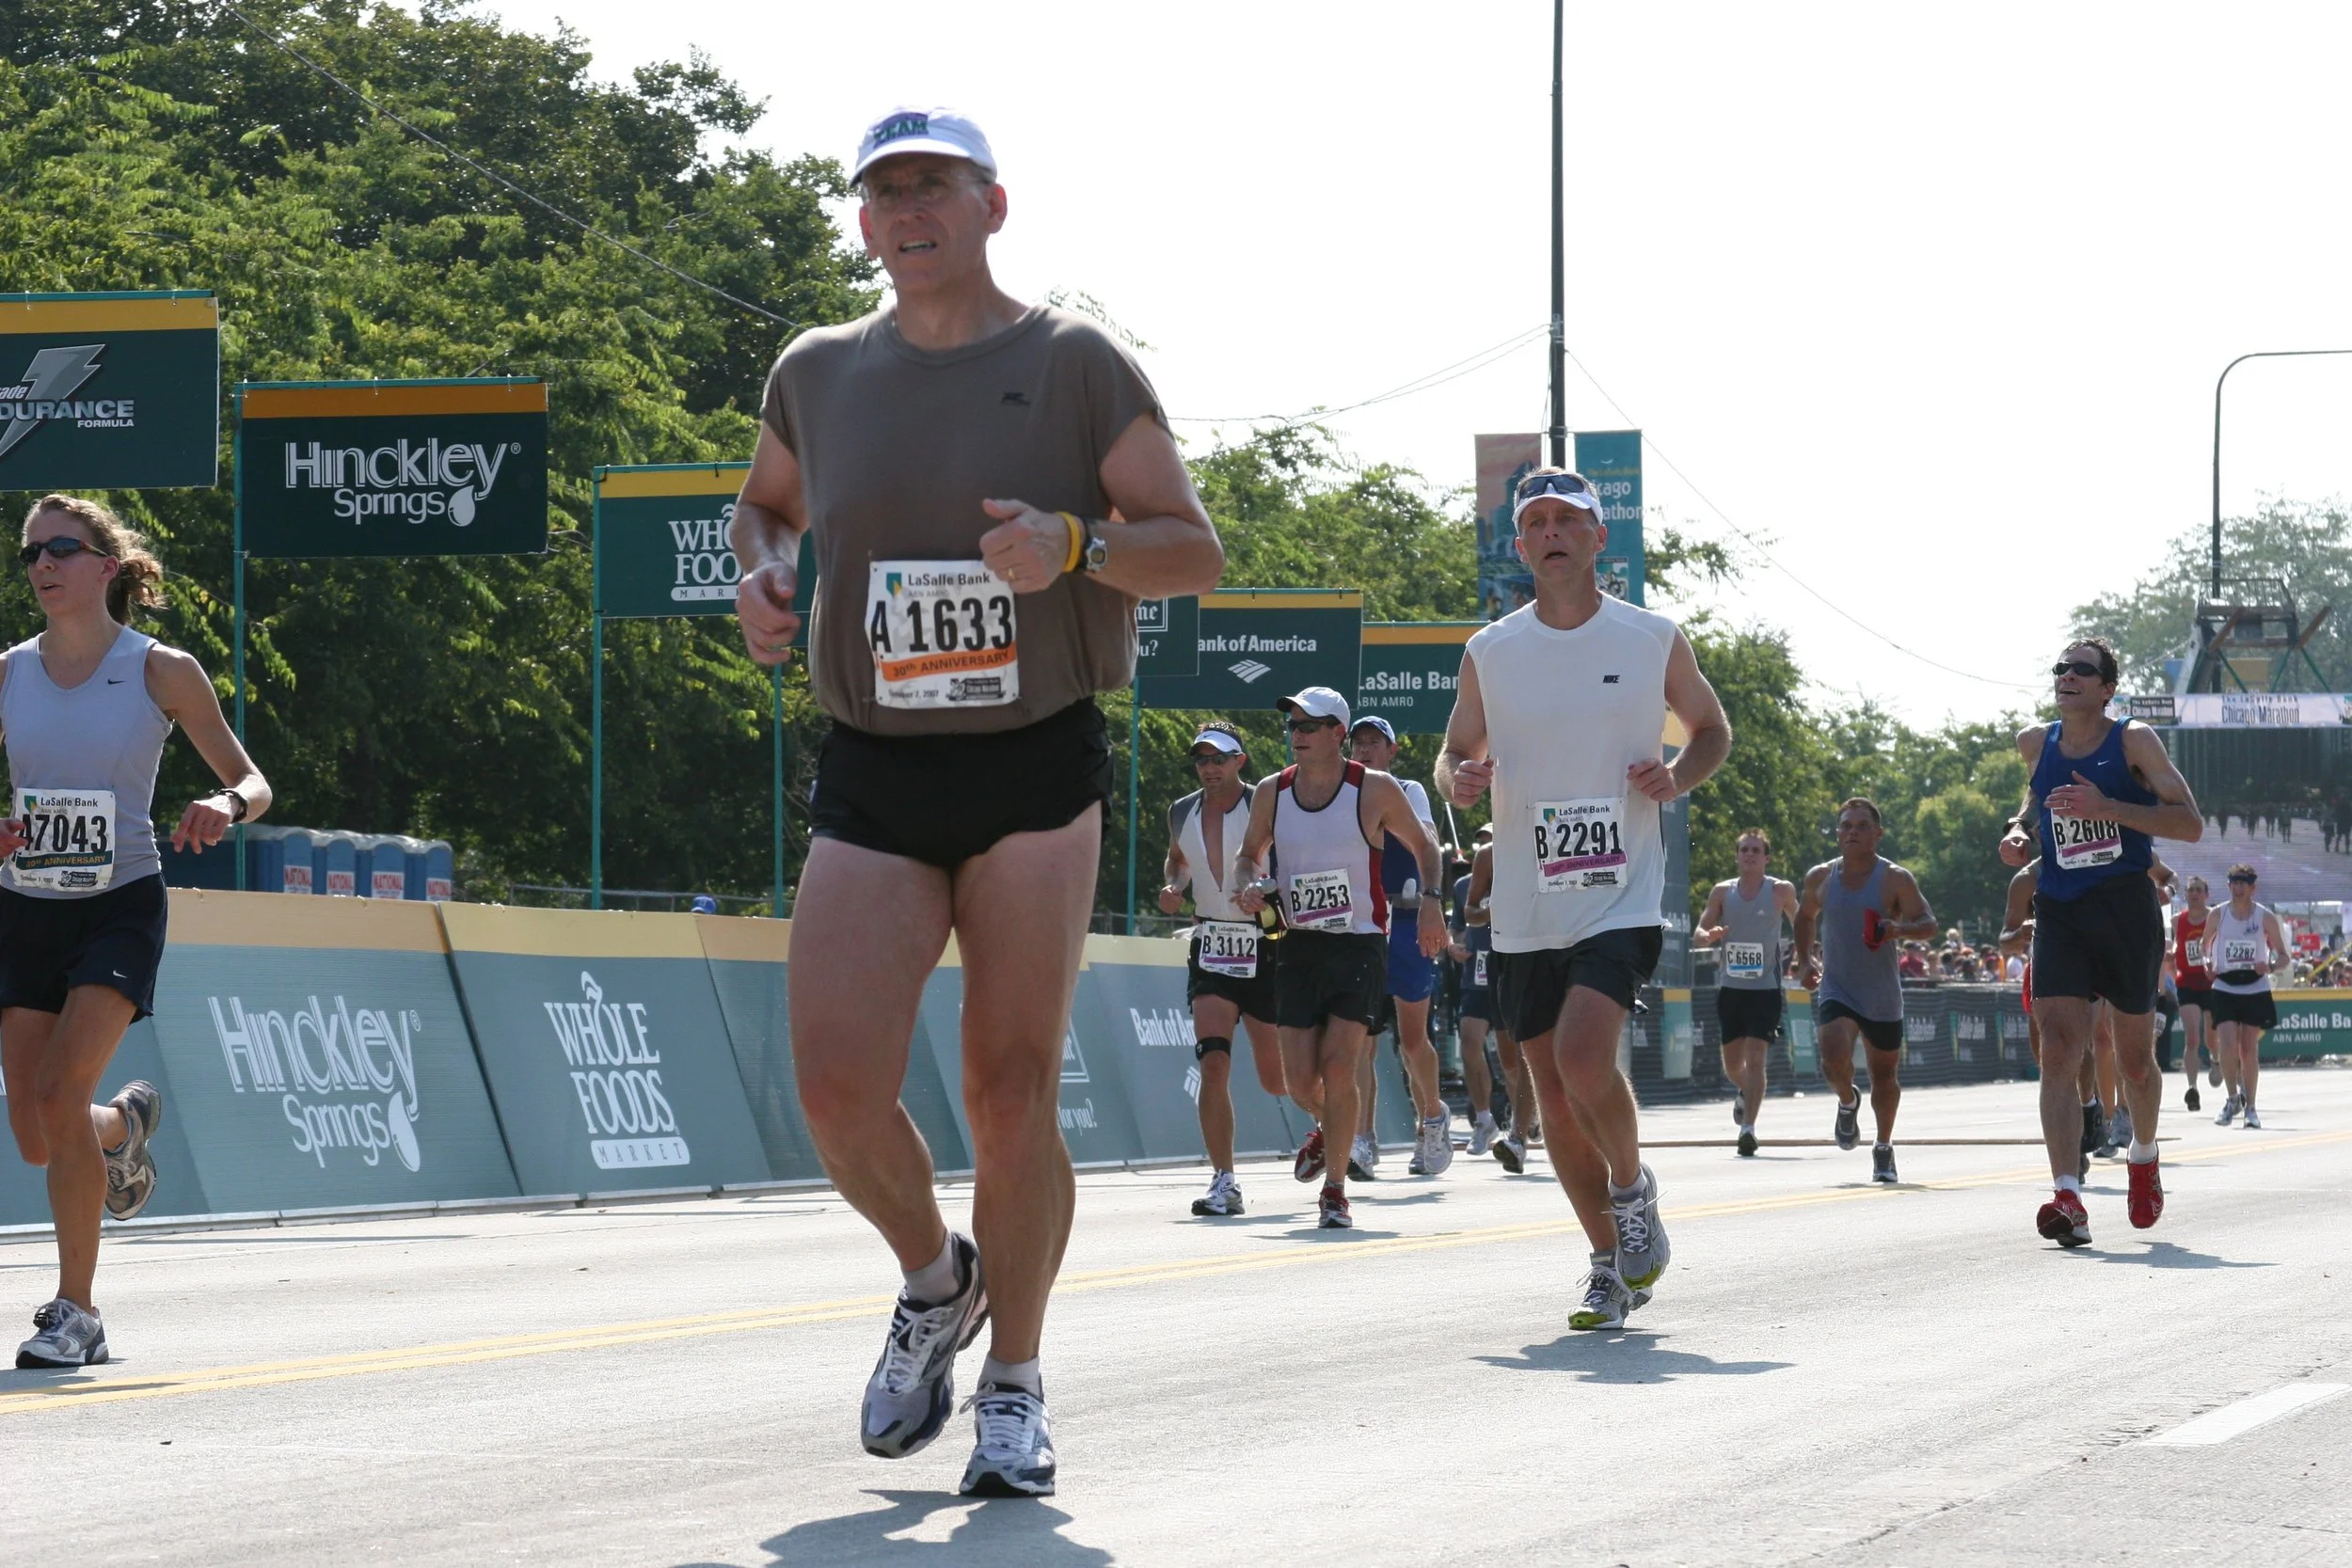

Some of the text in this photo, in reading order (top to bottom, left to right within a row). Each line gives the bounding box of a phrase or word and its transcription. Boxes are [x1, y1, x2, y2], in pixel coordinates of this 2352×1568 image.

[0, 385, 29, 400] ade
[77, 420, 135, 429] FORMULA
[1593, 480, 1632, 499] cago
[334, 487, 446, 526] Springs
[908, 571, 991, 587] LaSalle Bank
[906, 595, 1013, 653] 1633
[1229, 635, 1247, 652] of
[1249, 635, 1317, 652] America
[920, 650, 1009, 673] ANNIVERSARY
[1602, 674, 1620, 684] NIKE
[1380, 696, 1414, 707] AMRO
[2221, 705, 2300, 726] Chicago Marathon
[40, 797, 98, 807] LaSalle Bank
[1559, 804, 1611, 816] LaSalle Bank
[19, 814, 107, 853] 47043
[1556, 821, 1623, 858] 2291
[2070, 819, 2117, 845] 2608
[44, 855, 106, 865] ANNIVERSARY
[1565, 854, 1621, 870] ANNIVERSARY
[1304, 884, 1350, 911] 2253
[1216, 936, 1256, 958] 3112
[1727, 950, 1762, 965] C 6568
[543, 1001, 661, 1067] WHOLE
[1130, 1007, 1169, 1046] Bank
[1164, 1007, 1182, 1046] of
[2273, 1034, 2321, 1042] ABN AMRO
[570, 1069, 675, 1135] FOODS
[1073, 1099, 1098, 1136] you?
[282, 1094, 391, 1168] Springs
[597, 1142, 683, 1164] MARKET
